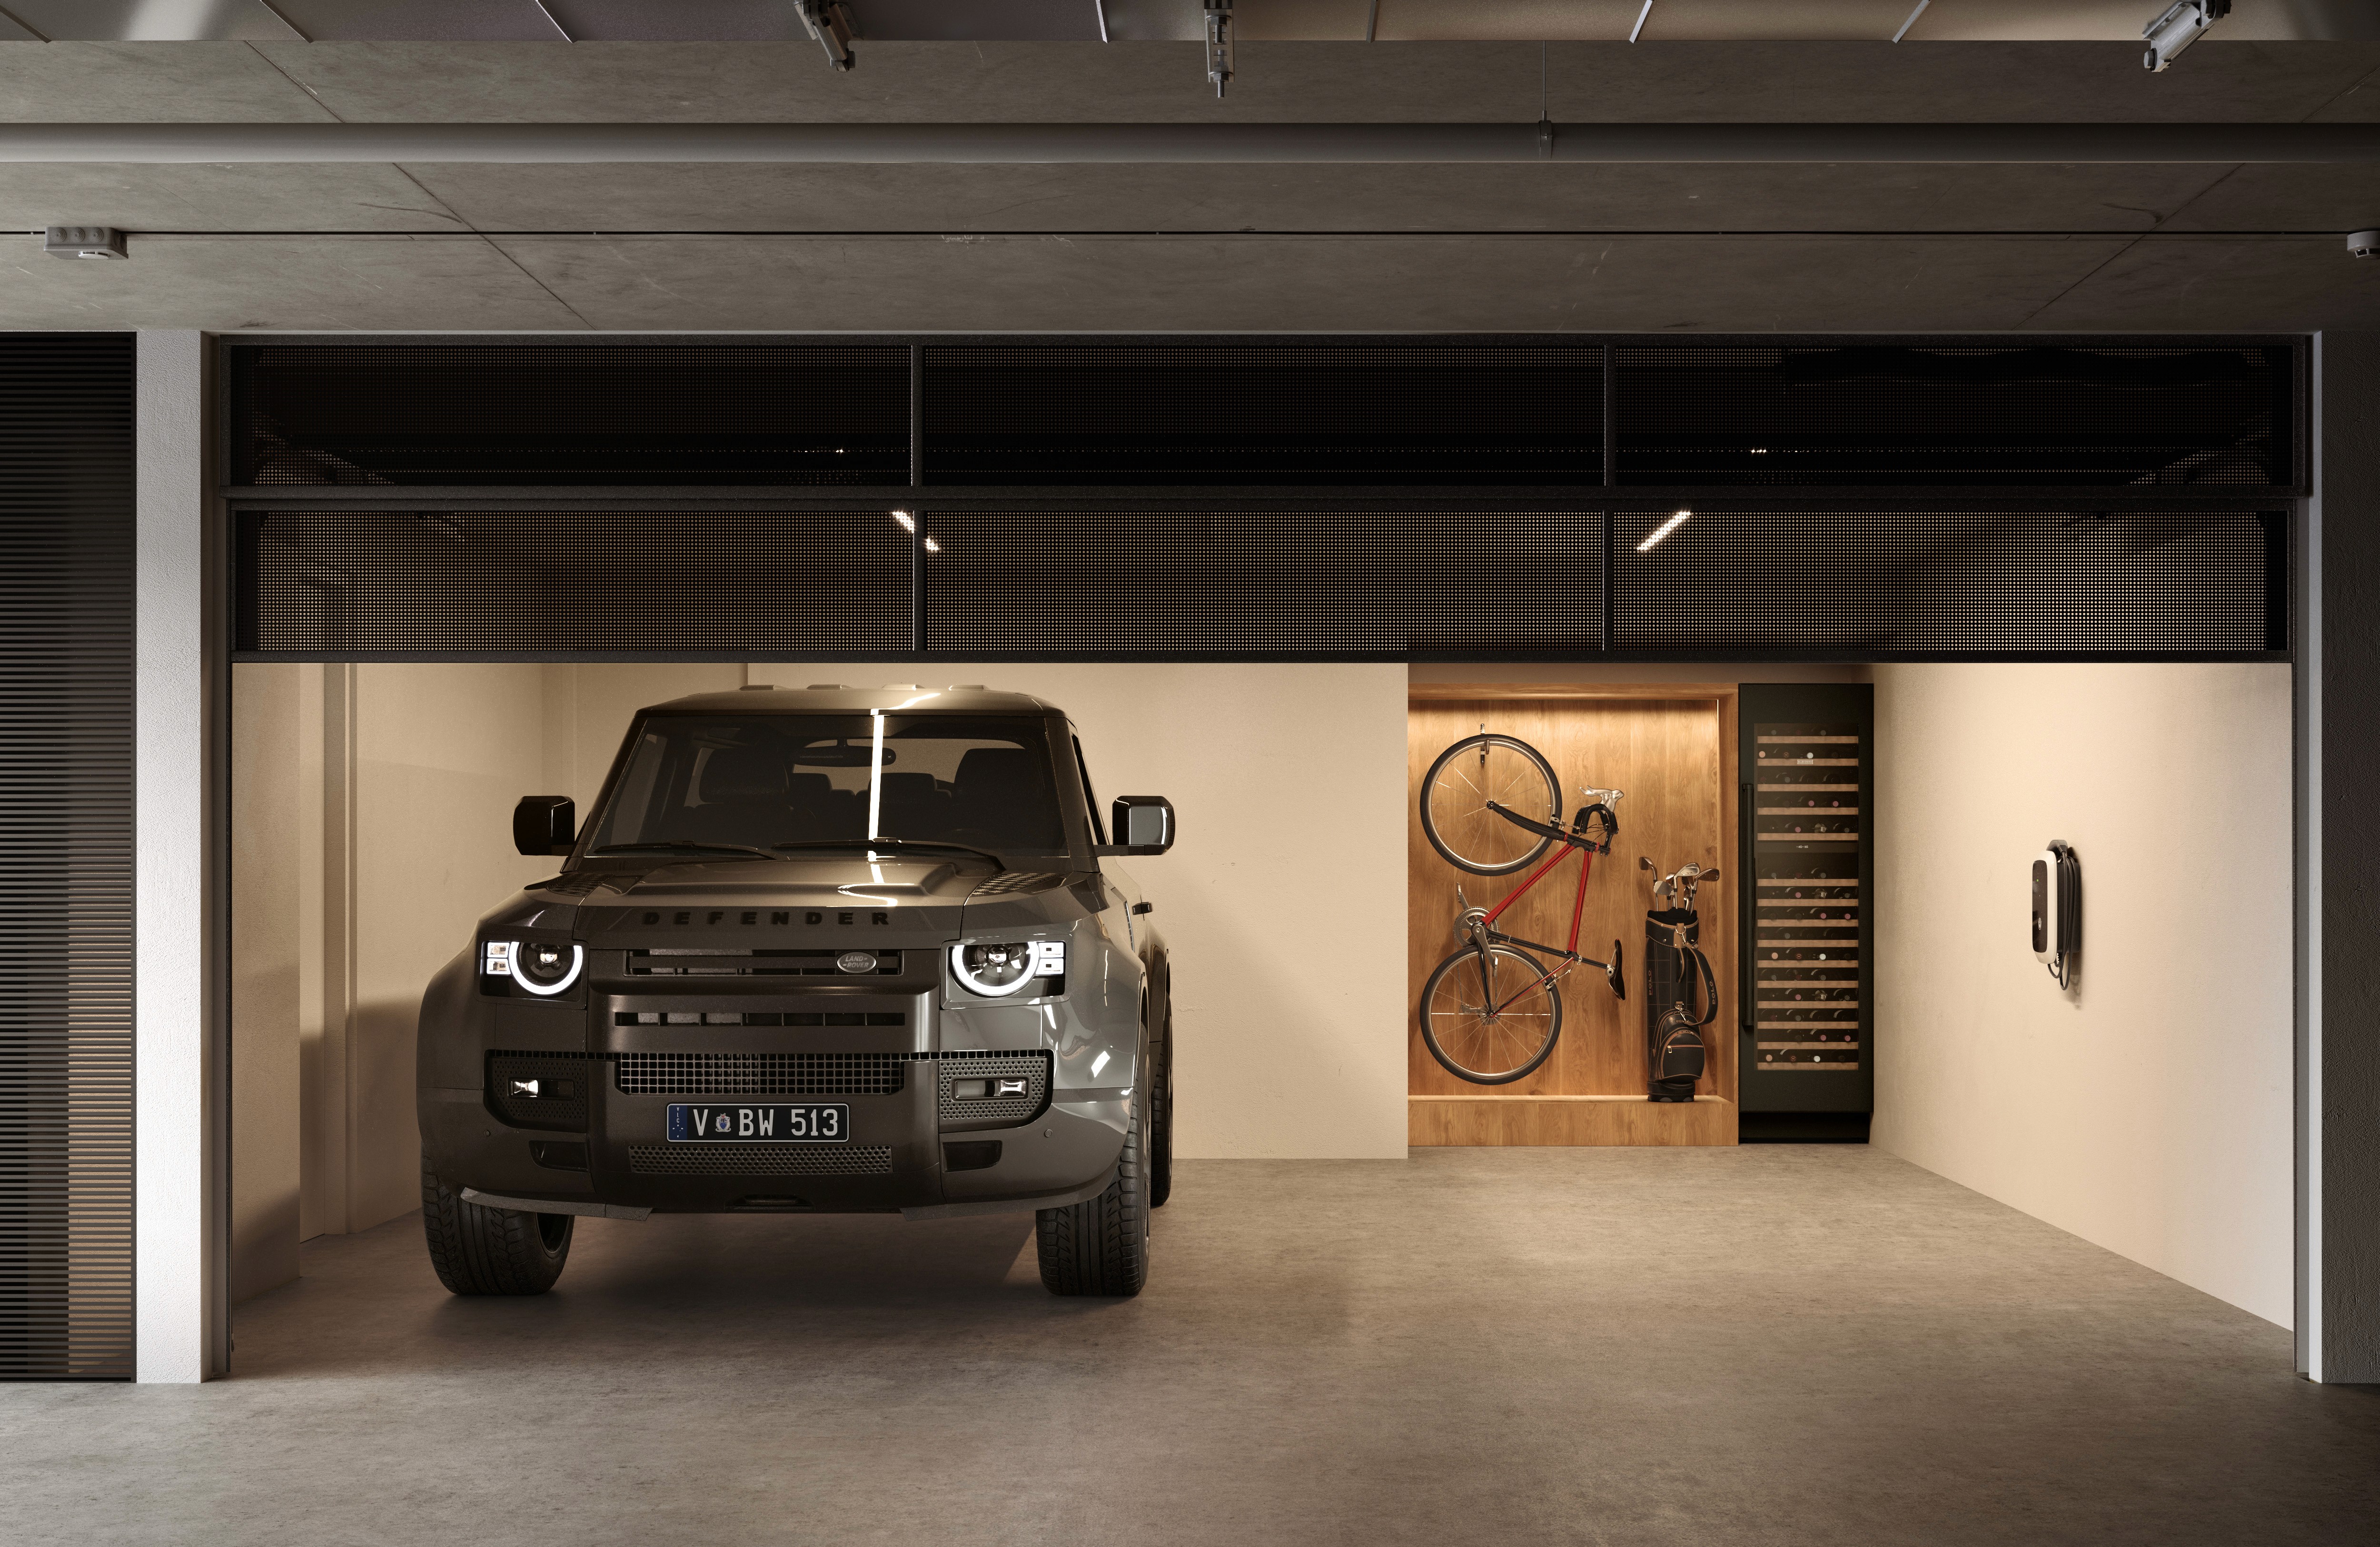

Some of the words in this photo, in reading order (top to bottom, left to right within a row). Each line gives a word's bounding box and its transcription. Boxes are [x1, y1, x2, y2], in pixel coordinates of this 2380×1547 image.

[643, 911, 889, 925] DEFENDER
[693, 1109, 709, 1136] V
[739, 1109, 774, 1136] BW
[791, 1109, 838, 1136] 513
